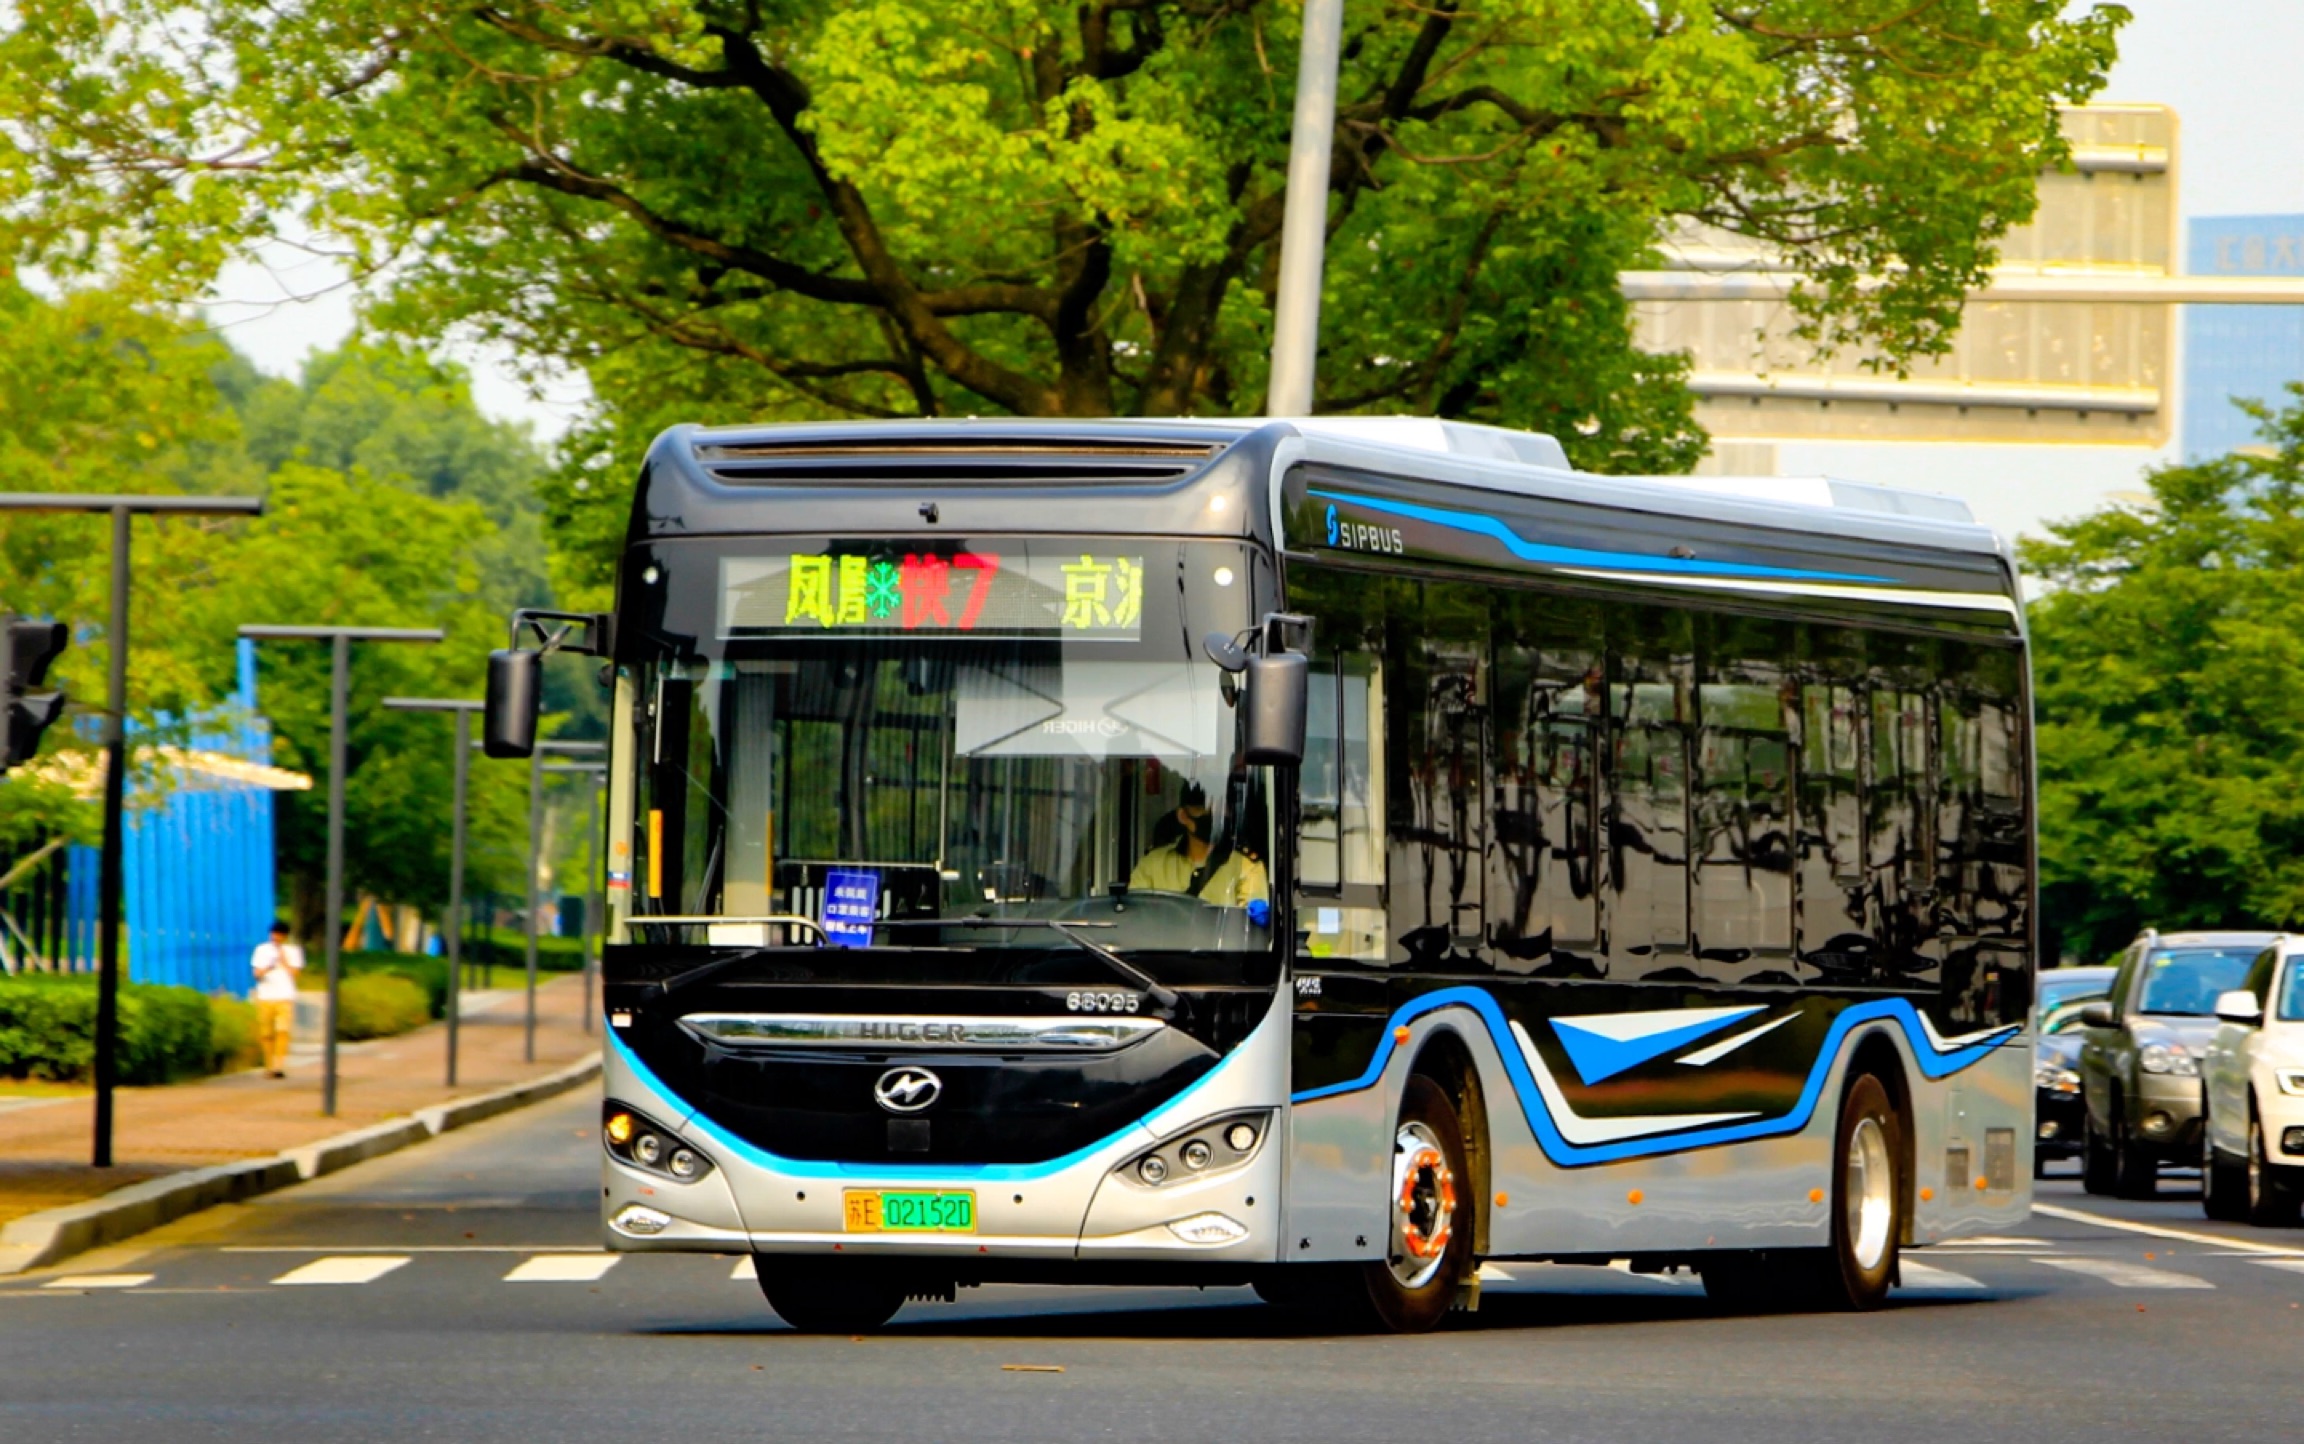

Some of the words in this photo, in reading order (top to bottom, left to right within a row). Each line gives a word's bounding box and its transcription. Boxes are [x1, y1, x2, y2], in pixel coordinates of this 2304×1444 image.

[1340, 522, 1403, 553] SIPBUS
[899, 553, 1000, 630] 快7
[860, 1022, 965, 1043] HIGER
[887, 1198, 971, 1227] 02152D
